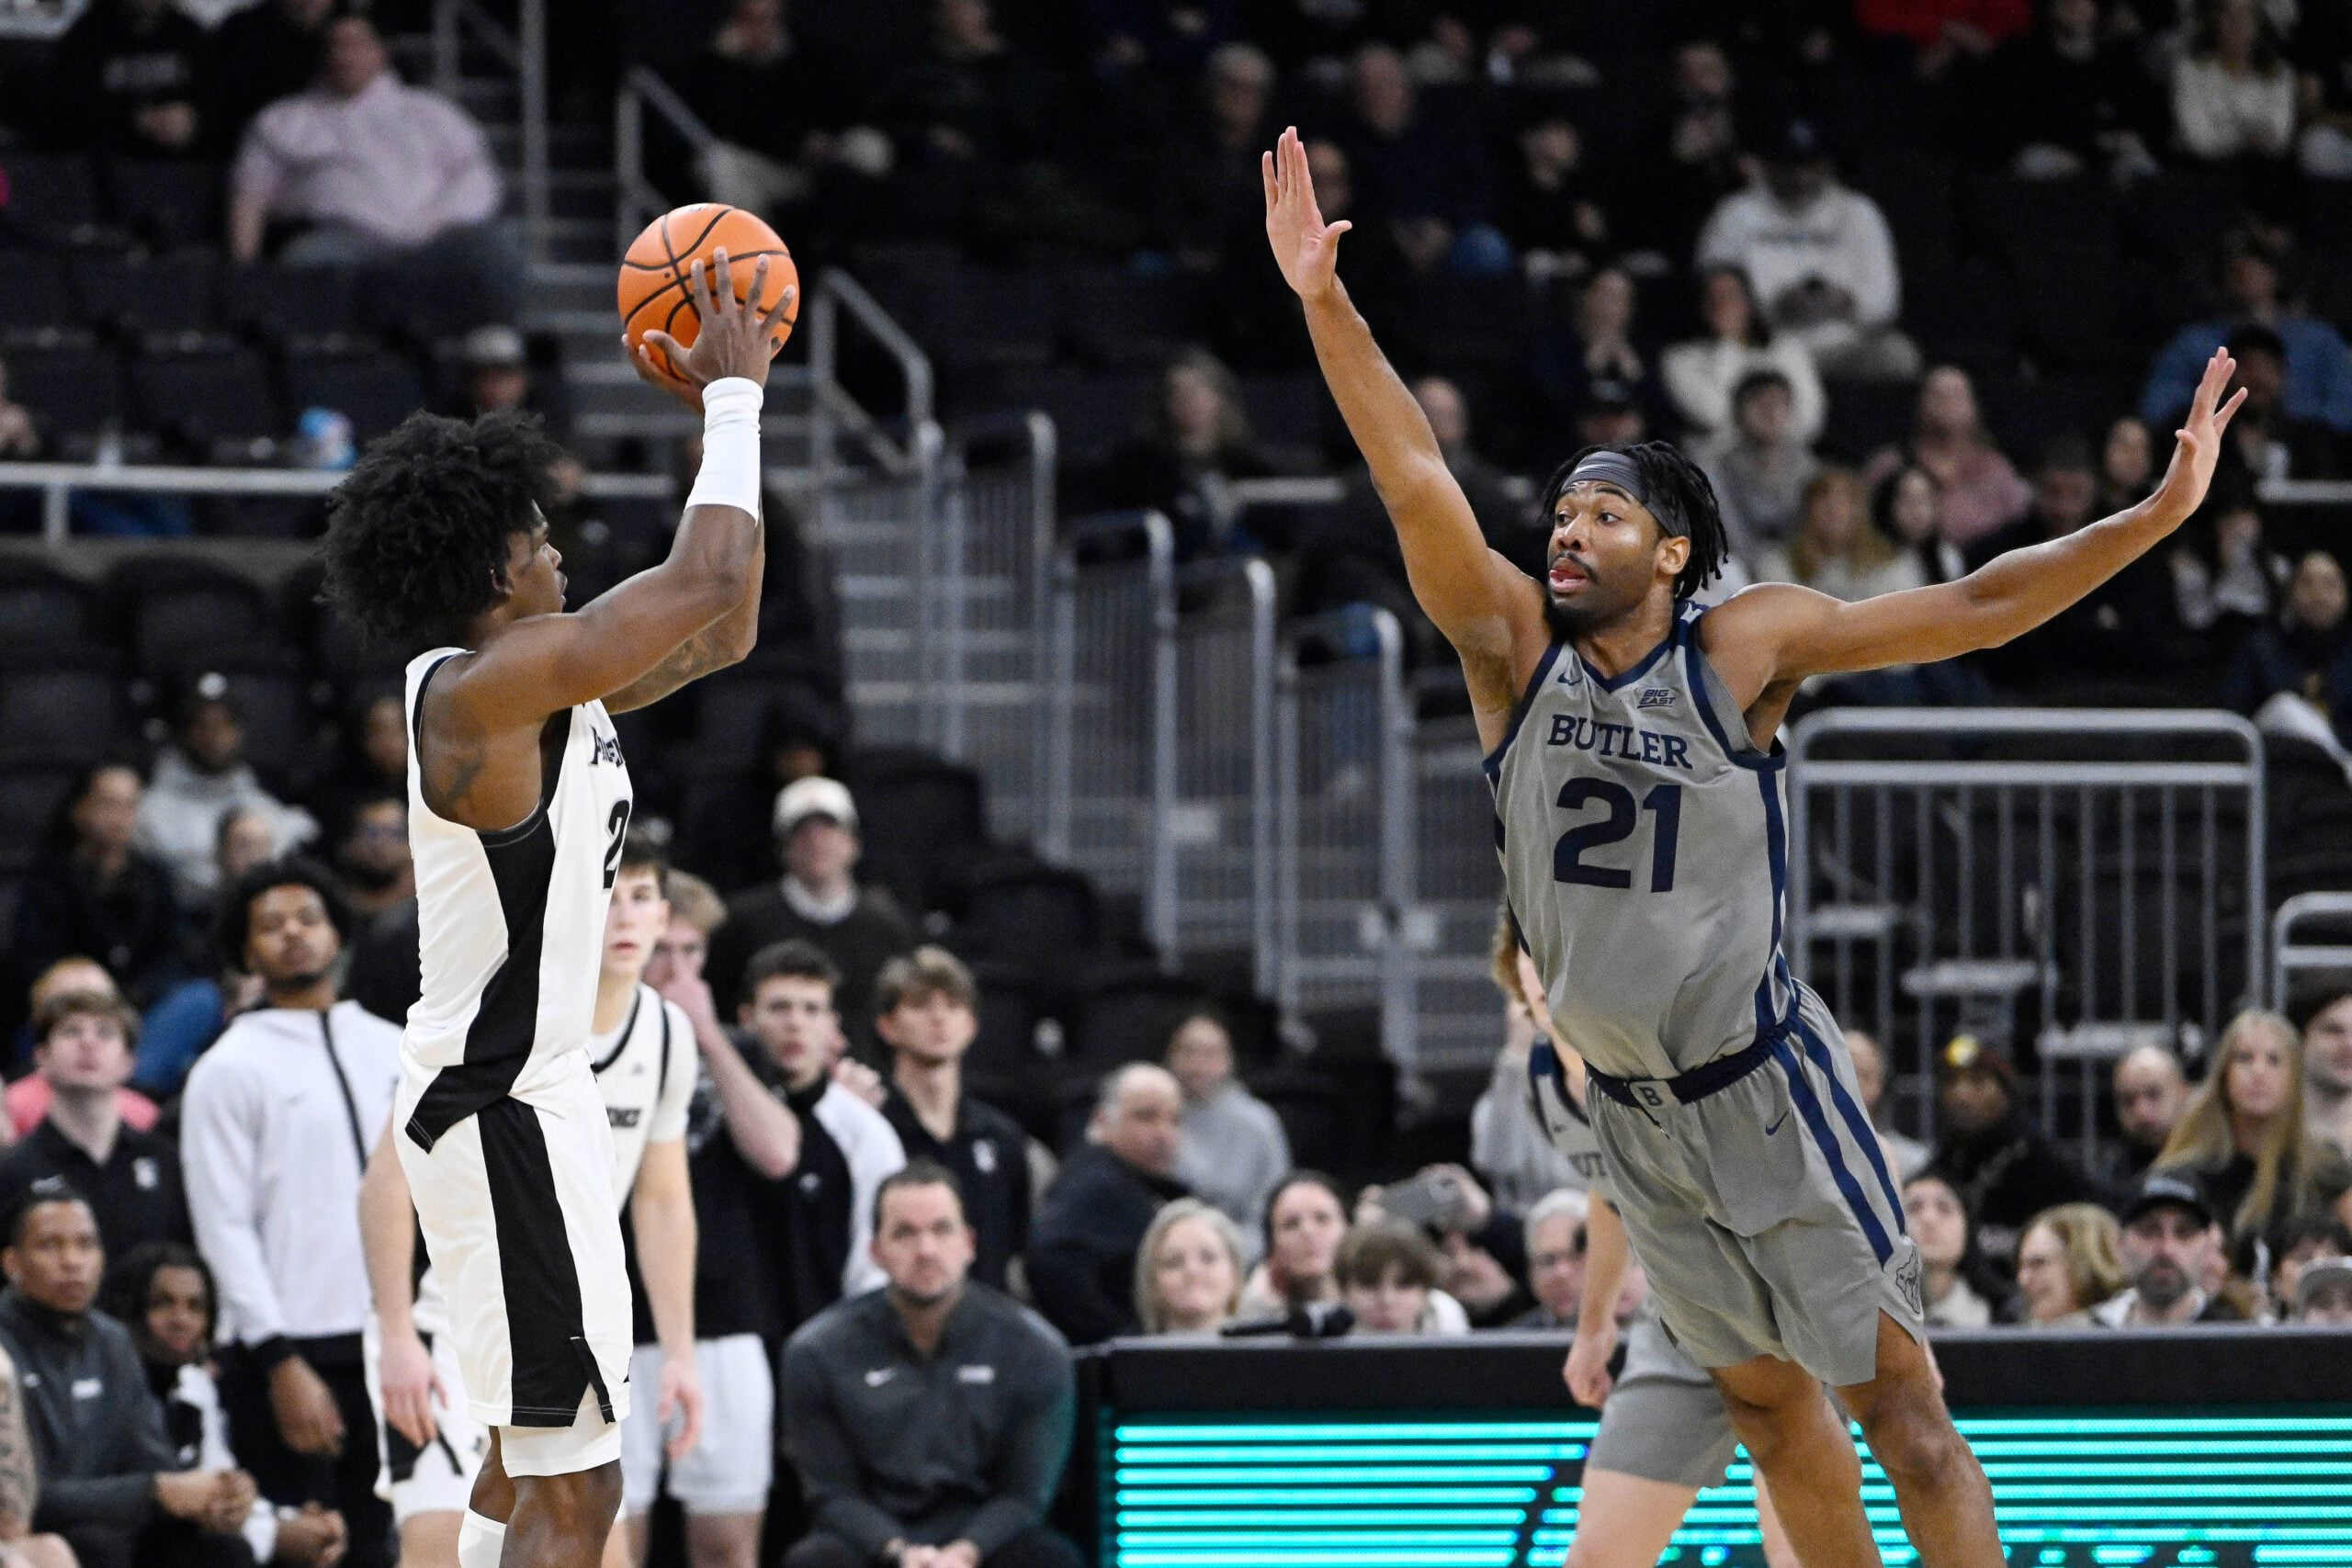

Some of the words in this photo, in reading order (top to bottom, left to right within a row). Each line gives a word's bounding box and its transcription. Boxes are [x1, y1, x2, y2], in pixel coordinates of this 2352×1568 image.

[1644, 689, 1669, 697] BIG
[1547, 714, 1692, 770] BUTLER
[1554, 777, 1681, 893] 21
[1639, 1087, 1662, 1107] B
